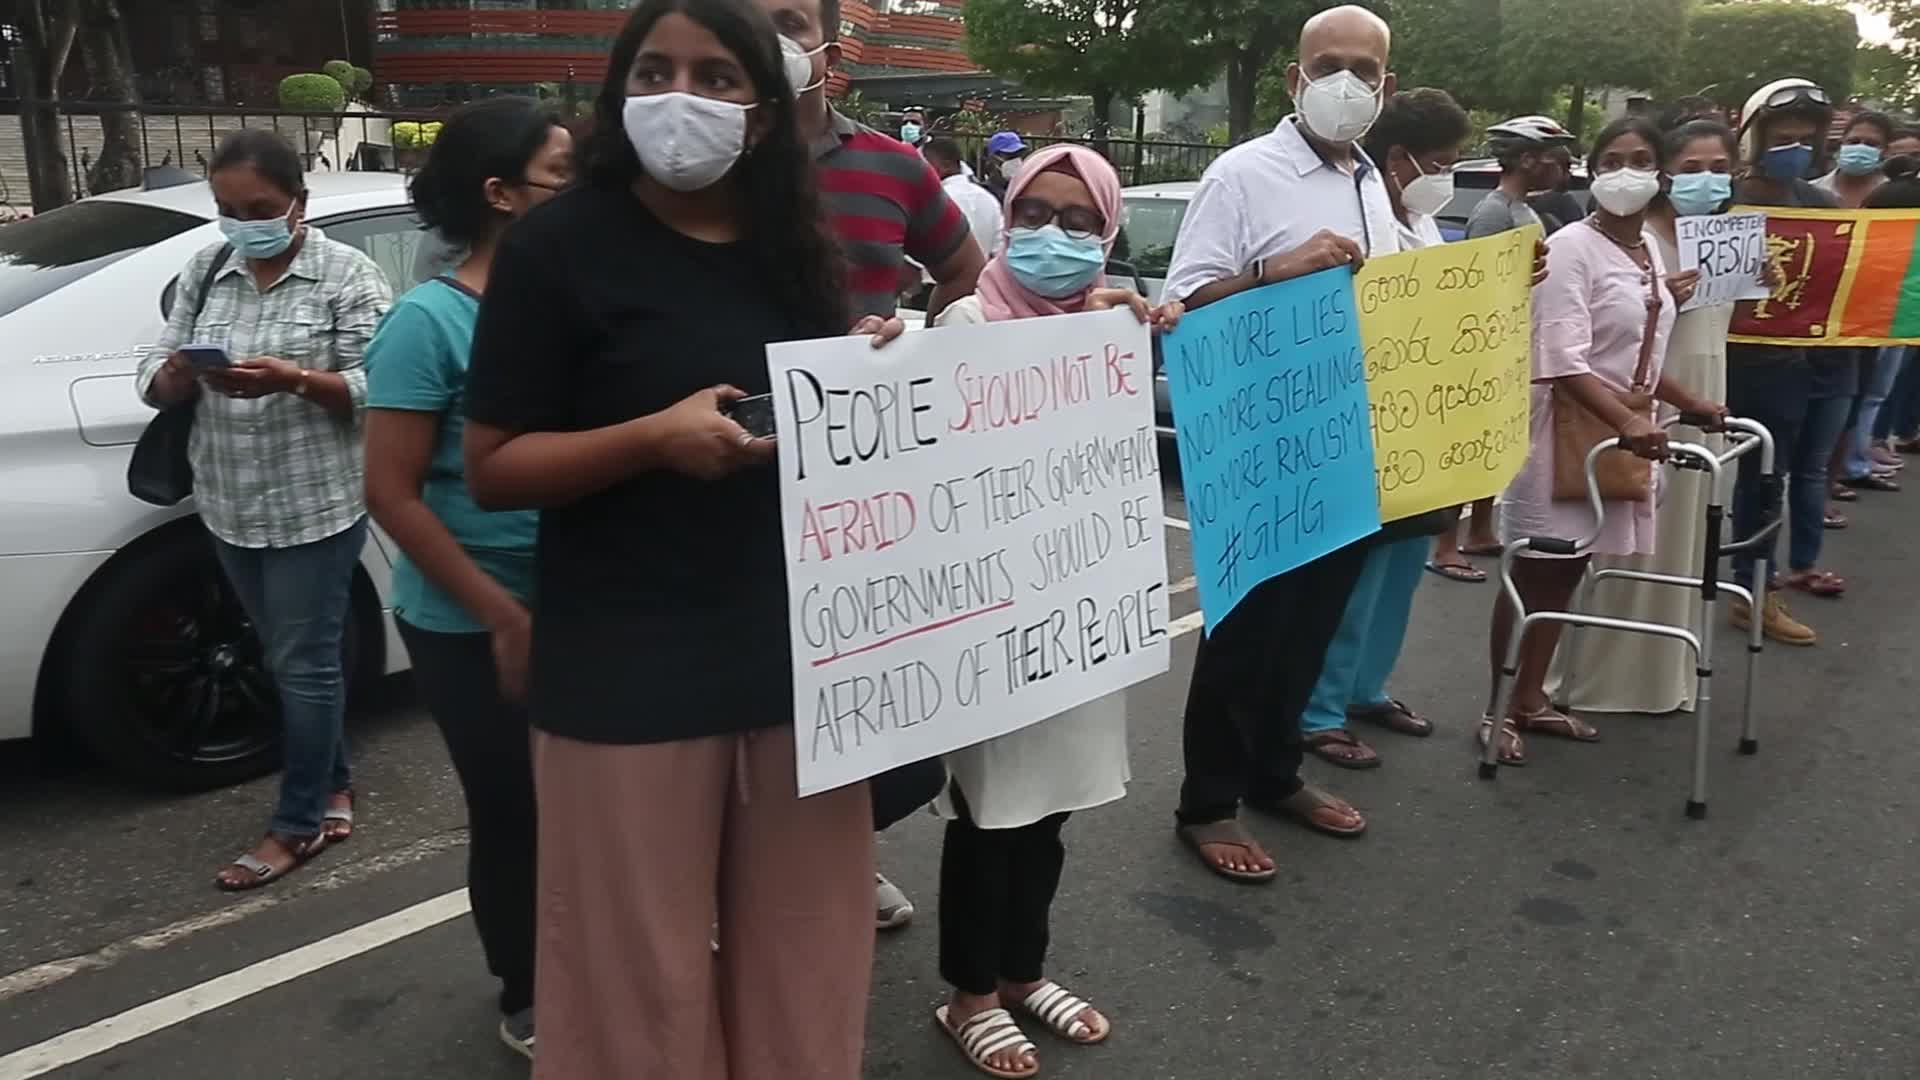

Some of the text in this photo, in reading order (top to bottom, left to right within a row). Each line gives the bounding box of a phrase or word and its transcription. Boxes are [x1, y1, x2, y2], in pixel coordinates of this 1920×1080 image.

[1181, 289, 1348, 396] NO MORE LIES
[1183, 345, 1363, 473] NO MORE STEALING
[786, 343, 1137, 481] PEOPLE SHOULD NOT BE
[1188, 401, 1365, 534] NO MORE RACISM
[799, 425, 1160, 563] AFRAID OF THEIR GOVERNMENTS
[1217, 477, 1326, 597] #GHG
[802, 495, 1152, 657] GOVERNMENTS SHOULD BE
[812, 581, 1168, 763] AFRAID OF THEIR PEOPLE
